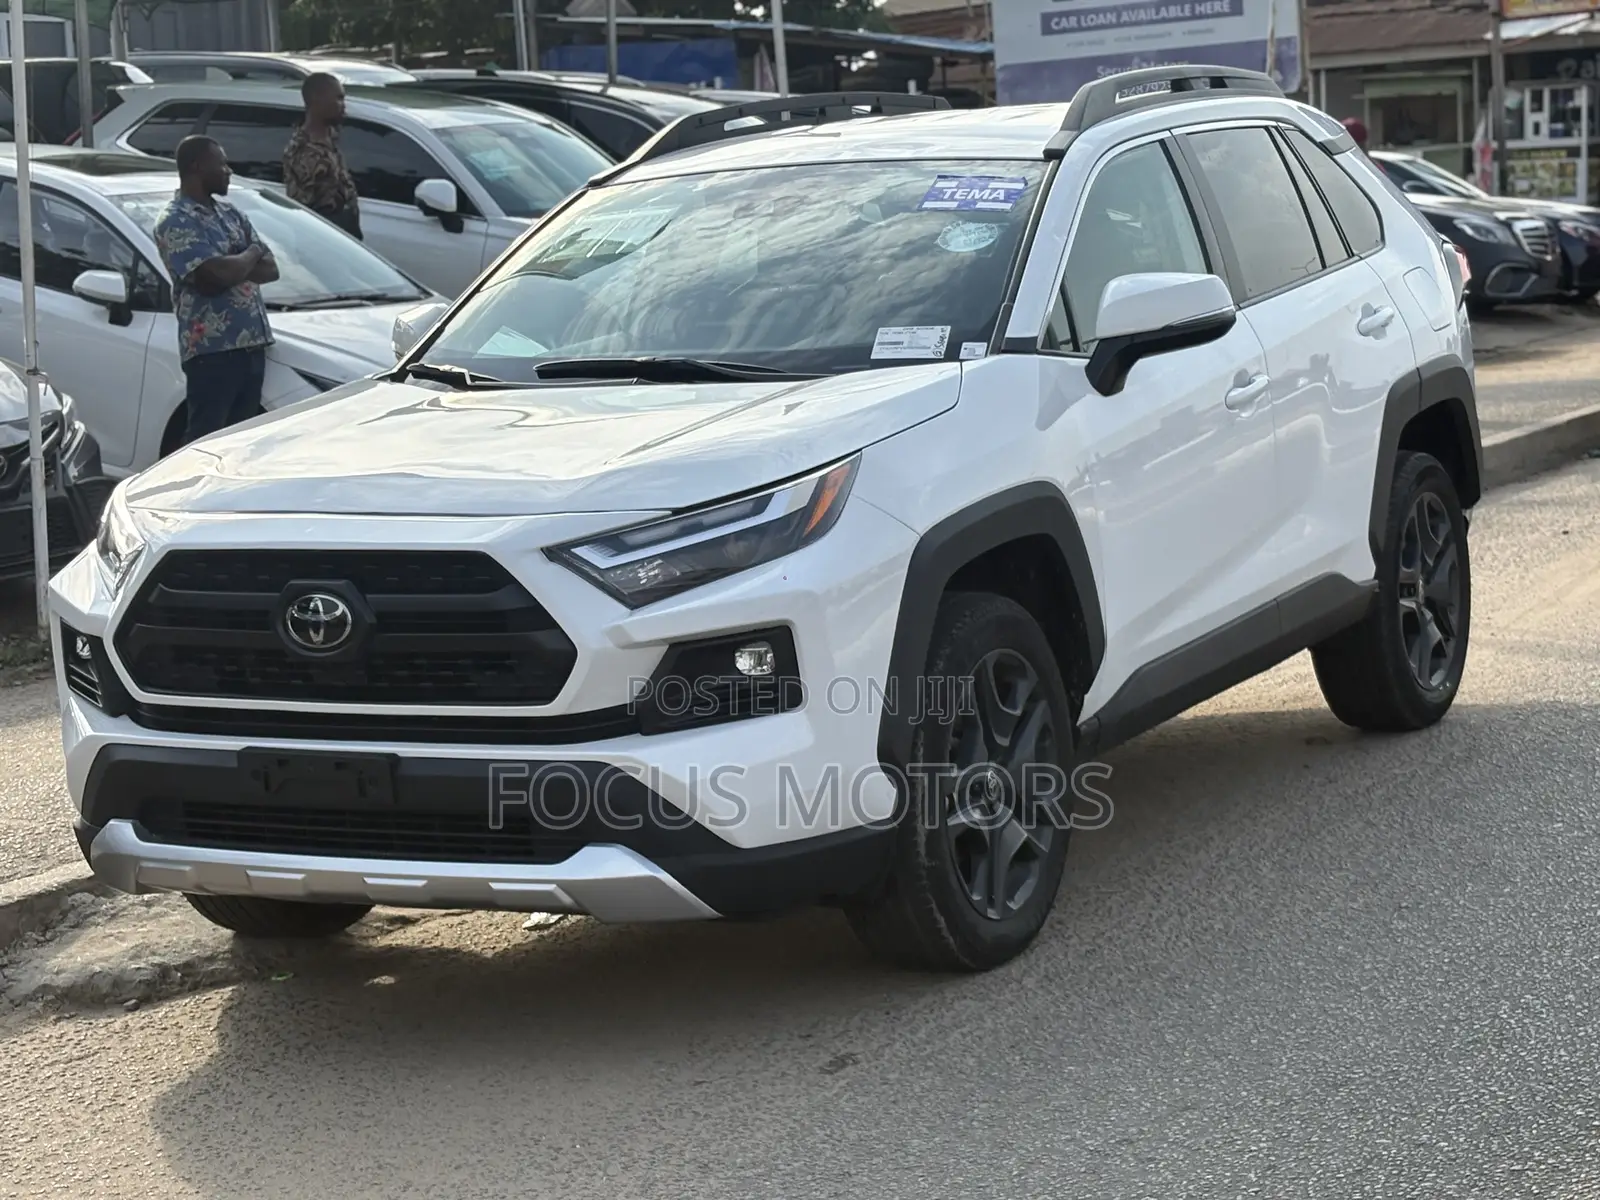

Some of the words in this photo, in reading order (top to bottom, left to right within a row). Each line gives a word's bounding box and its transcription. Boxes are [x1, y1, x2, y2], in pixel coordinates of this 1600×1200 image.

[1051, 15, 1078, 31] CAR
[1080, 11, 1117, 28] LOAN
[1119, 4, 1192, 24] AVAILABLE
[1195, 0, 1231, 15] HERE
[943, 188, 1005, 200] TEMA
